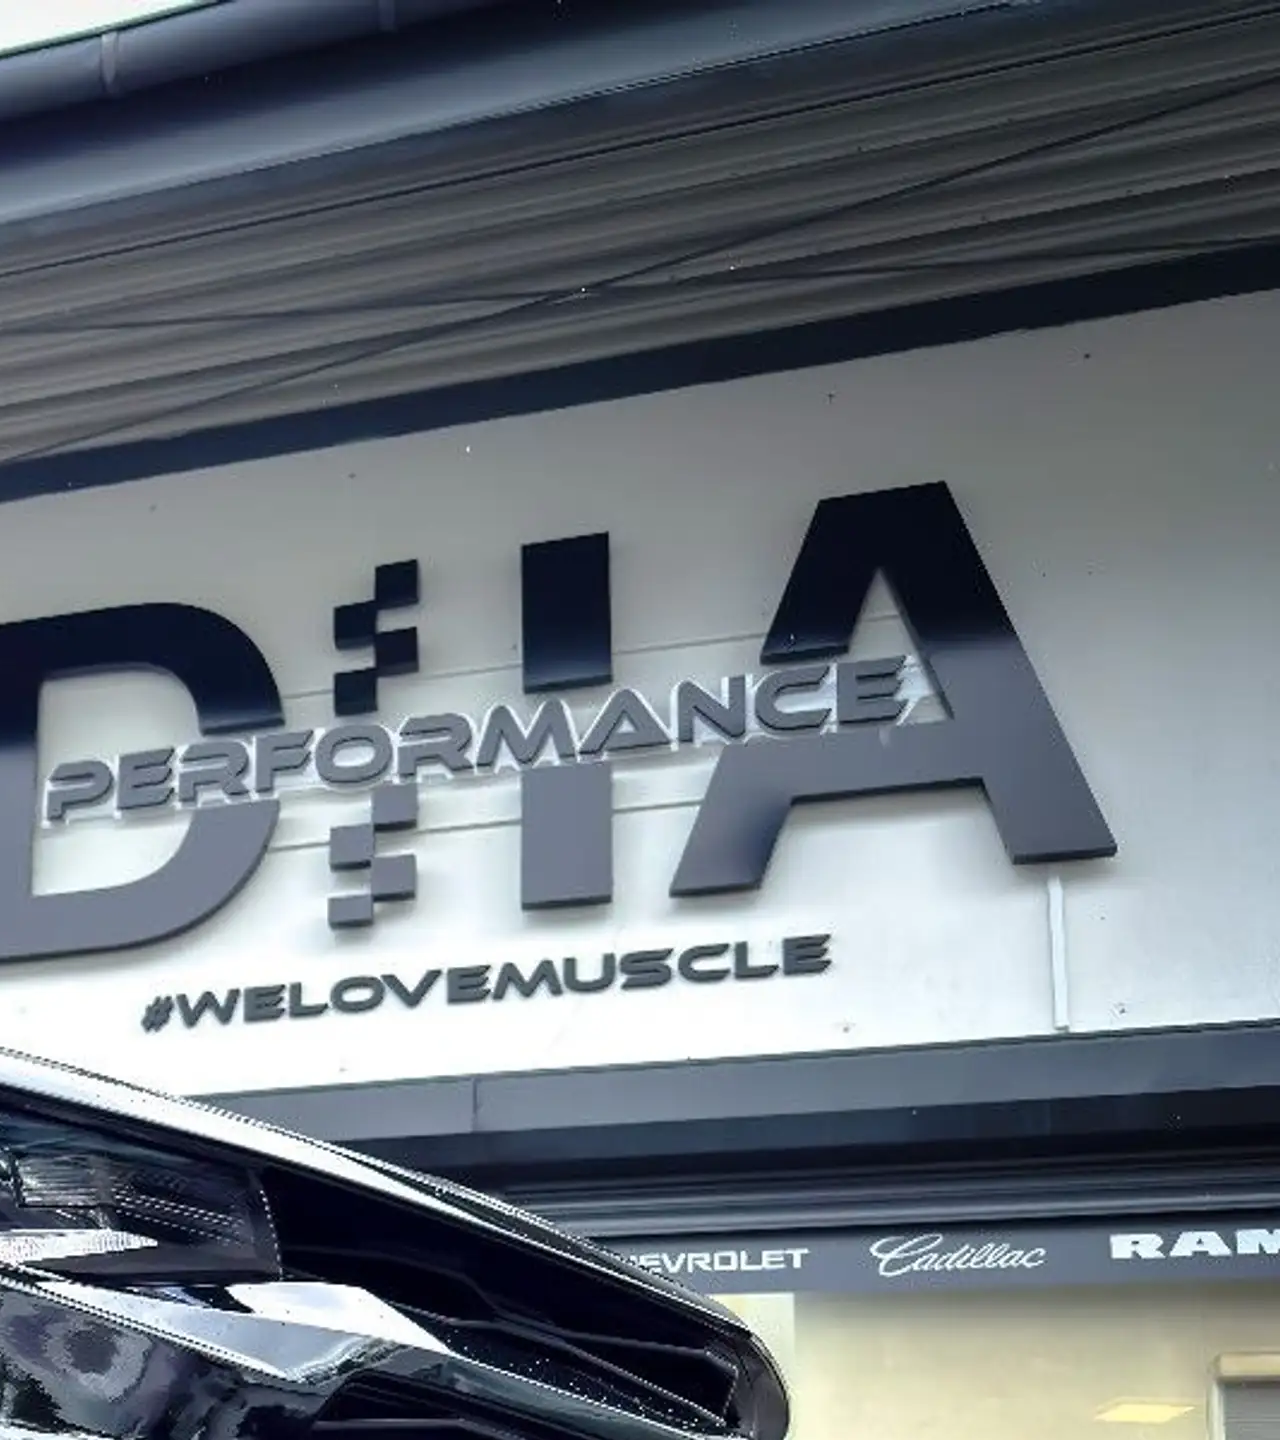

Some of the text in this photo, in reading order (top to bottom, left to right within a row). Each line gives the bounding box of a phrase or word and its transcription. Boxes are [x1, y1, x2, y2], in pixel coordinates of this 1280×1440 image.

[44, 654, 910, 824] PERFORMANCE
[140, 934, 831, 1032] #WELOVEMUSCLE
[628, 1248, 810, 1273] EVROLET
[869, 1233, 1046, 1277] Cadillac
[1109, 1229, 1280, 1259] RAM
